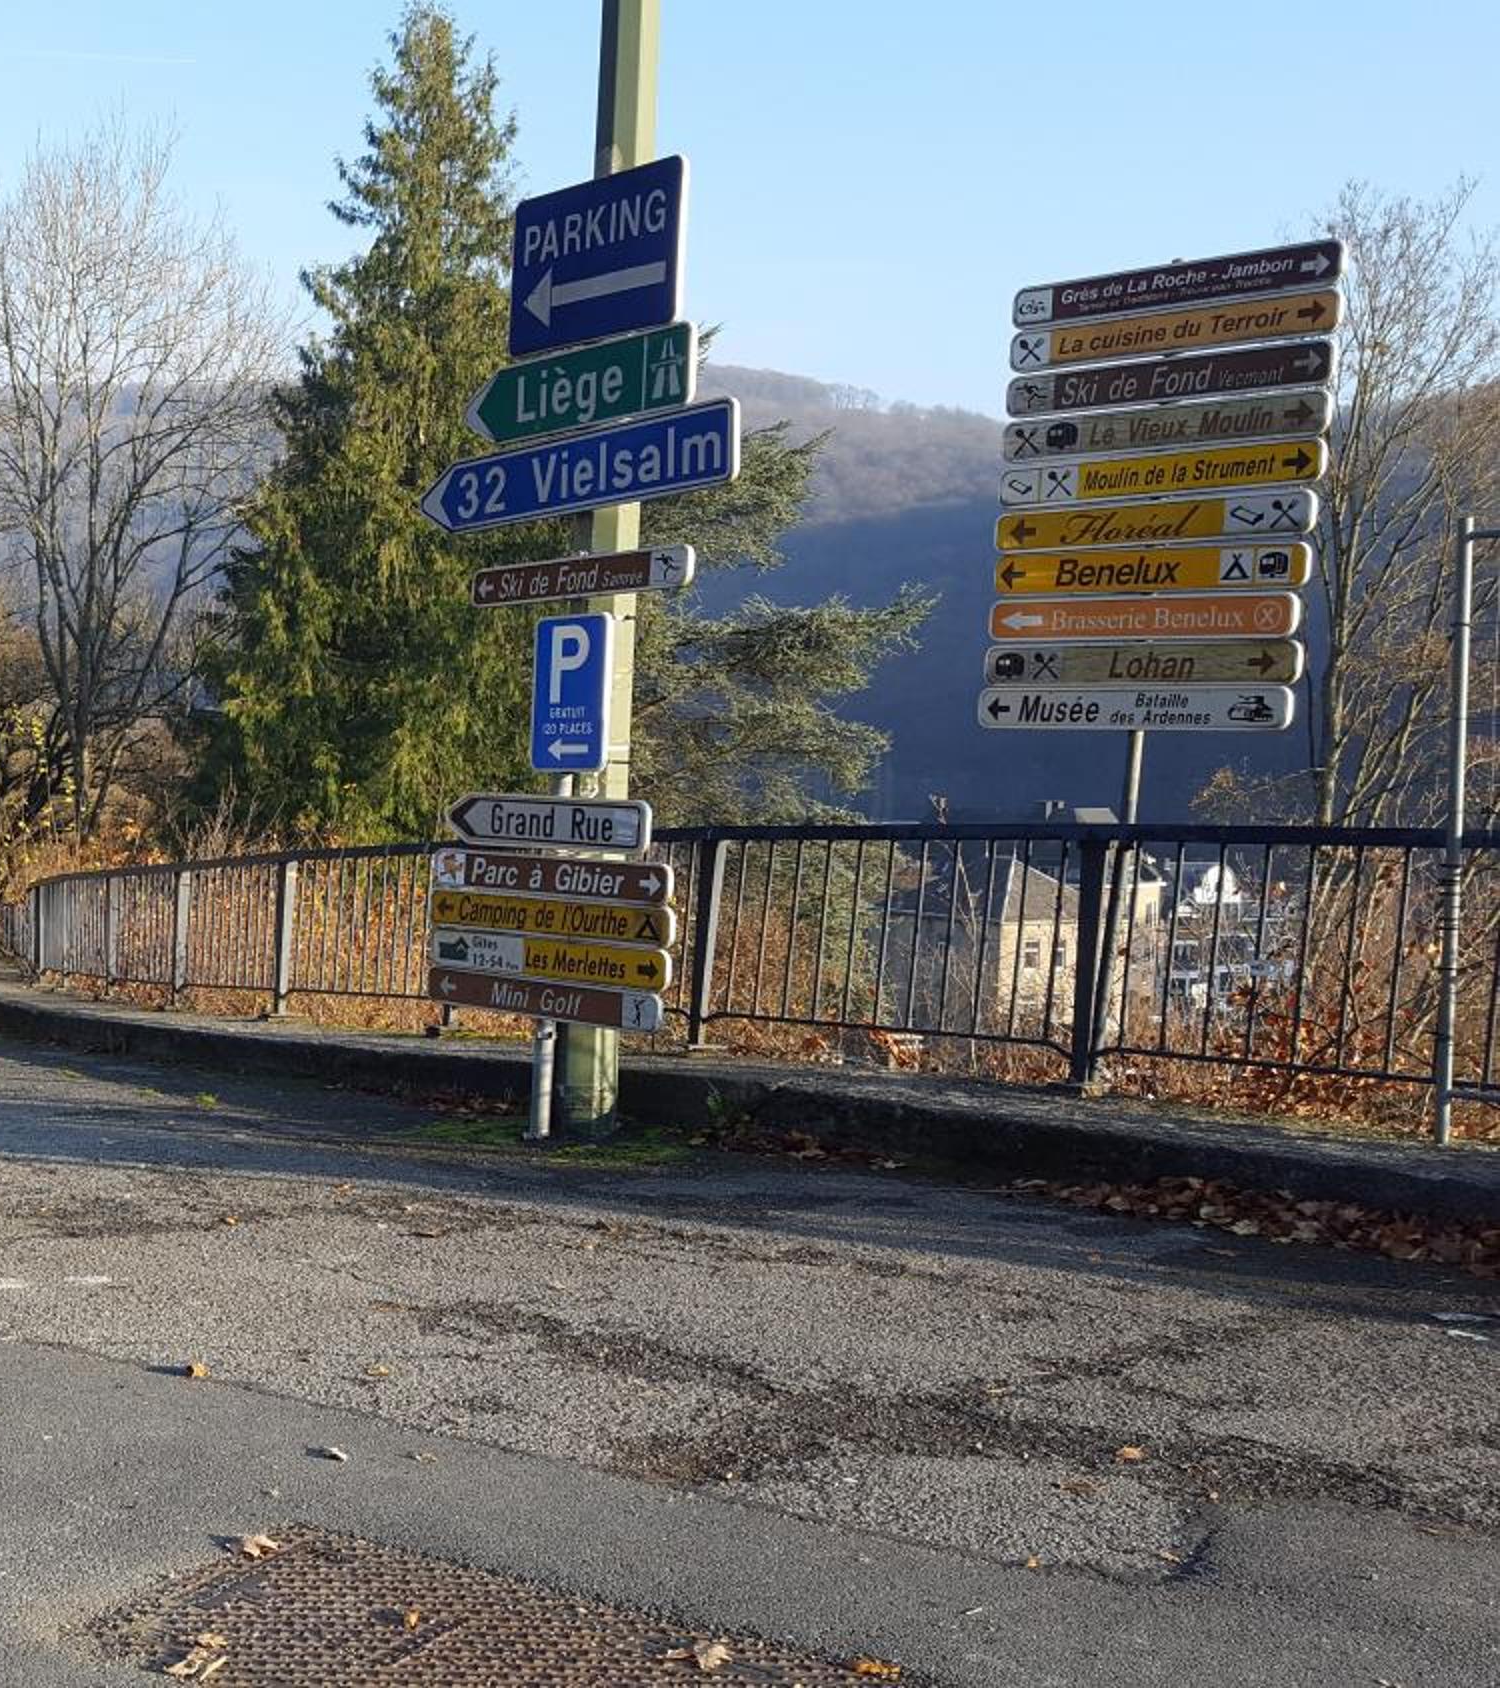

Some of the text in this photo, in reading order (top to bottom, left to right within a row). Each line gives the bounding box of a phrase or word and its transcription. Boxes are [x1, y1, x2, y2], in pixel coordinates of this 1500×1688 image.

[523, 188, 667, 267] PARKING
[1103, 283, 1123, 297] de
[1127, 279, 1147, 294] La
[1152, 270, 1207, 289] Roche
[1222, 259, 1293, 280] Jambon
[1058, 307, 1289, 355] La cuisine du Terroir
[516, 363, 624, 424] Liège
[1061, 378, 1098, 405] Ski
[1109, 373, 1139, 399] de
[1150, 364, 1213, 396] Fond
[1089, 408, 1273, 446] Le Vieux Moulin
[457, 426, 721, 519] 32 Vielsalm
[1084, 453, 1275, 491] Moulin de la Strument
[1059, 505, 1200, 545] Floréal
[500, 572, 525, 599] Ski
[529, 571, 549, 594] de
[556, 564, 599, 592] Fond
[1054, 558, 1182, 588] Benelux
[1050, 605, 1245, 631] Brasserie Benelux
[550, 625, 591, 704] P
[1108, 651, 1195, 680] Lohan
[1018, 694, 1099, 723] Musée
[1110, 709, 1212, 725] des Ardennes
[1135, 692, 1189, 709] Bataille
[491, 804, 613, 842] Grand Rue
[471, 857, 624, 894] Parc à Gibier
[459, 897, 628, 935] Camping de l'Ourthe
[525, 945, 626, 979] Les Merlettes
[490, 982, 581, 1017] Mini Golf
